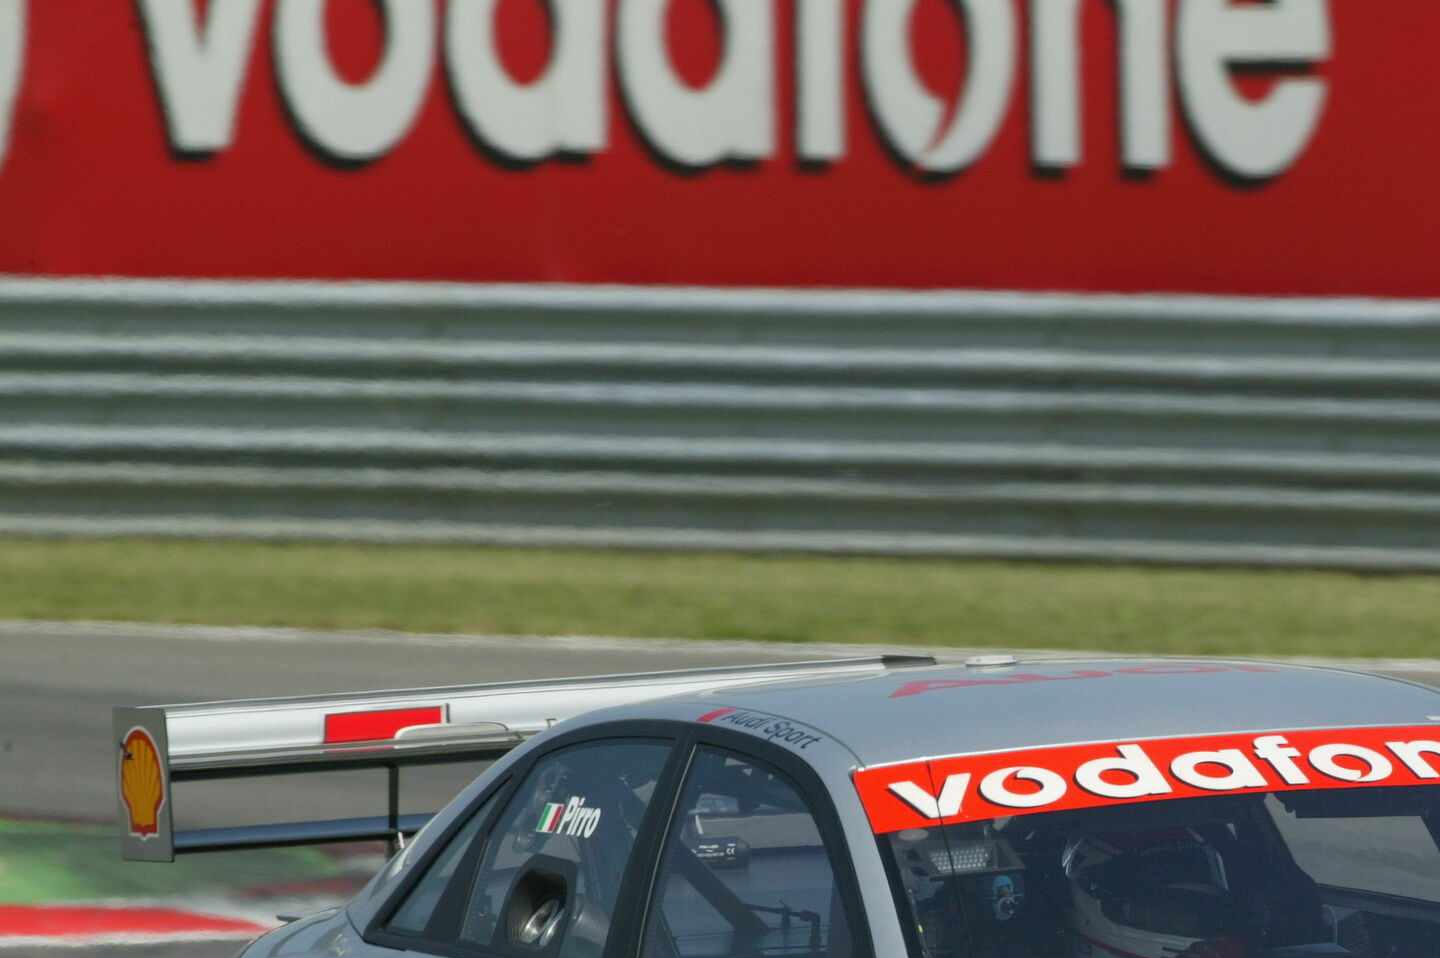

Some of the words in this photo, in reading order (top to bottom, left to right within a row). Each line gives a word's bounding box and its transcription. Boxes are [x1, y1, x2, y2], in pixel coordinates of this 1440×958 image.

[721, 711, 776, 730] Audi
[764, 720, 822, 749] Sport
[556, 795, 601, 839] Pirro
